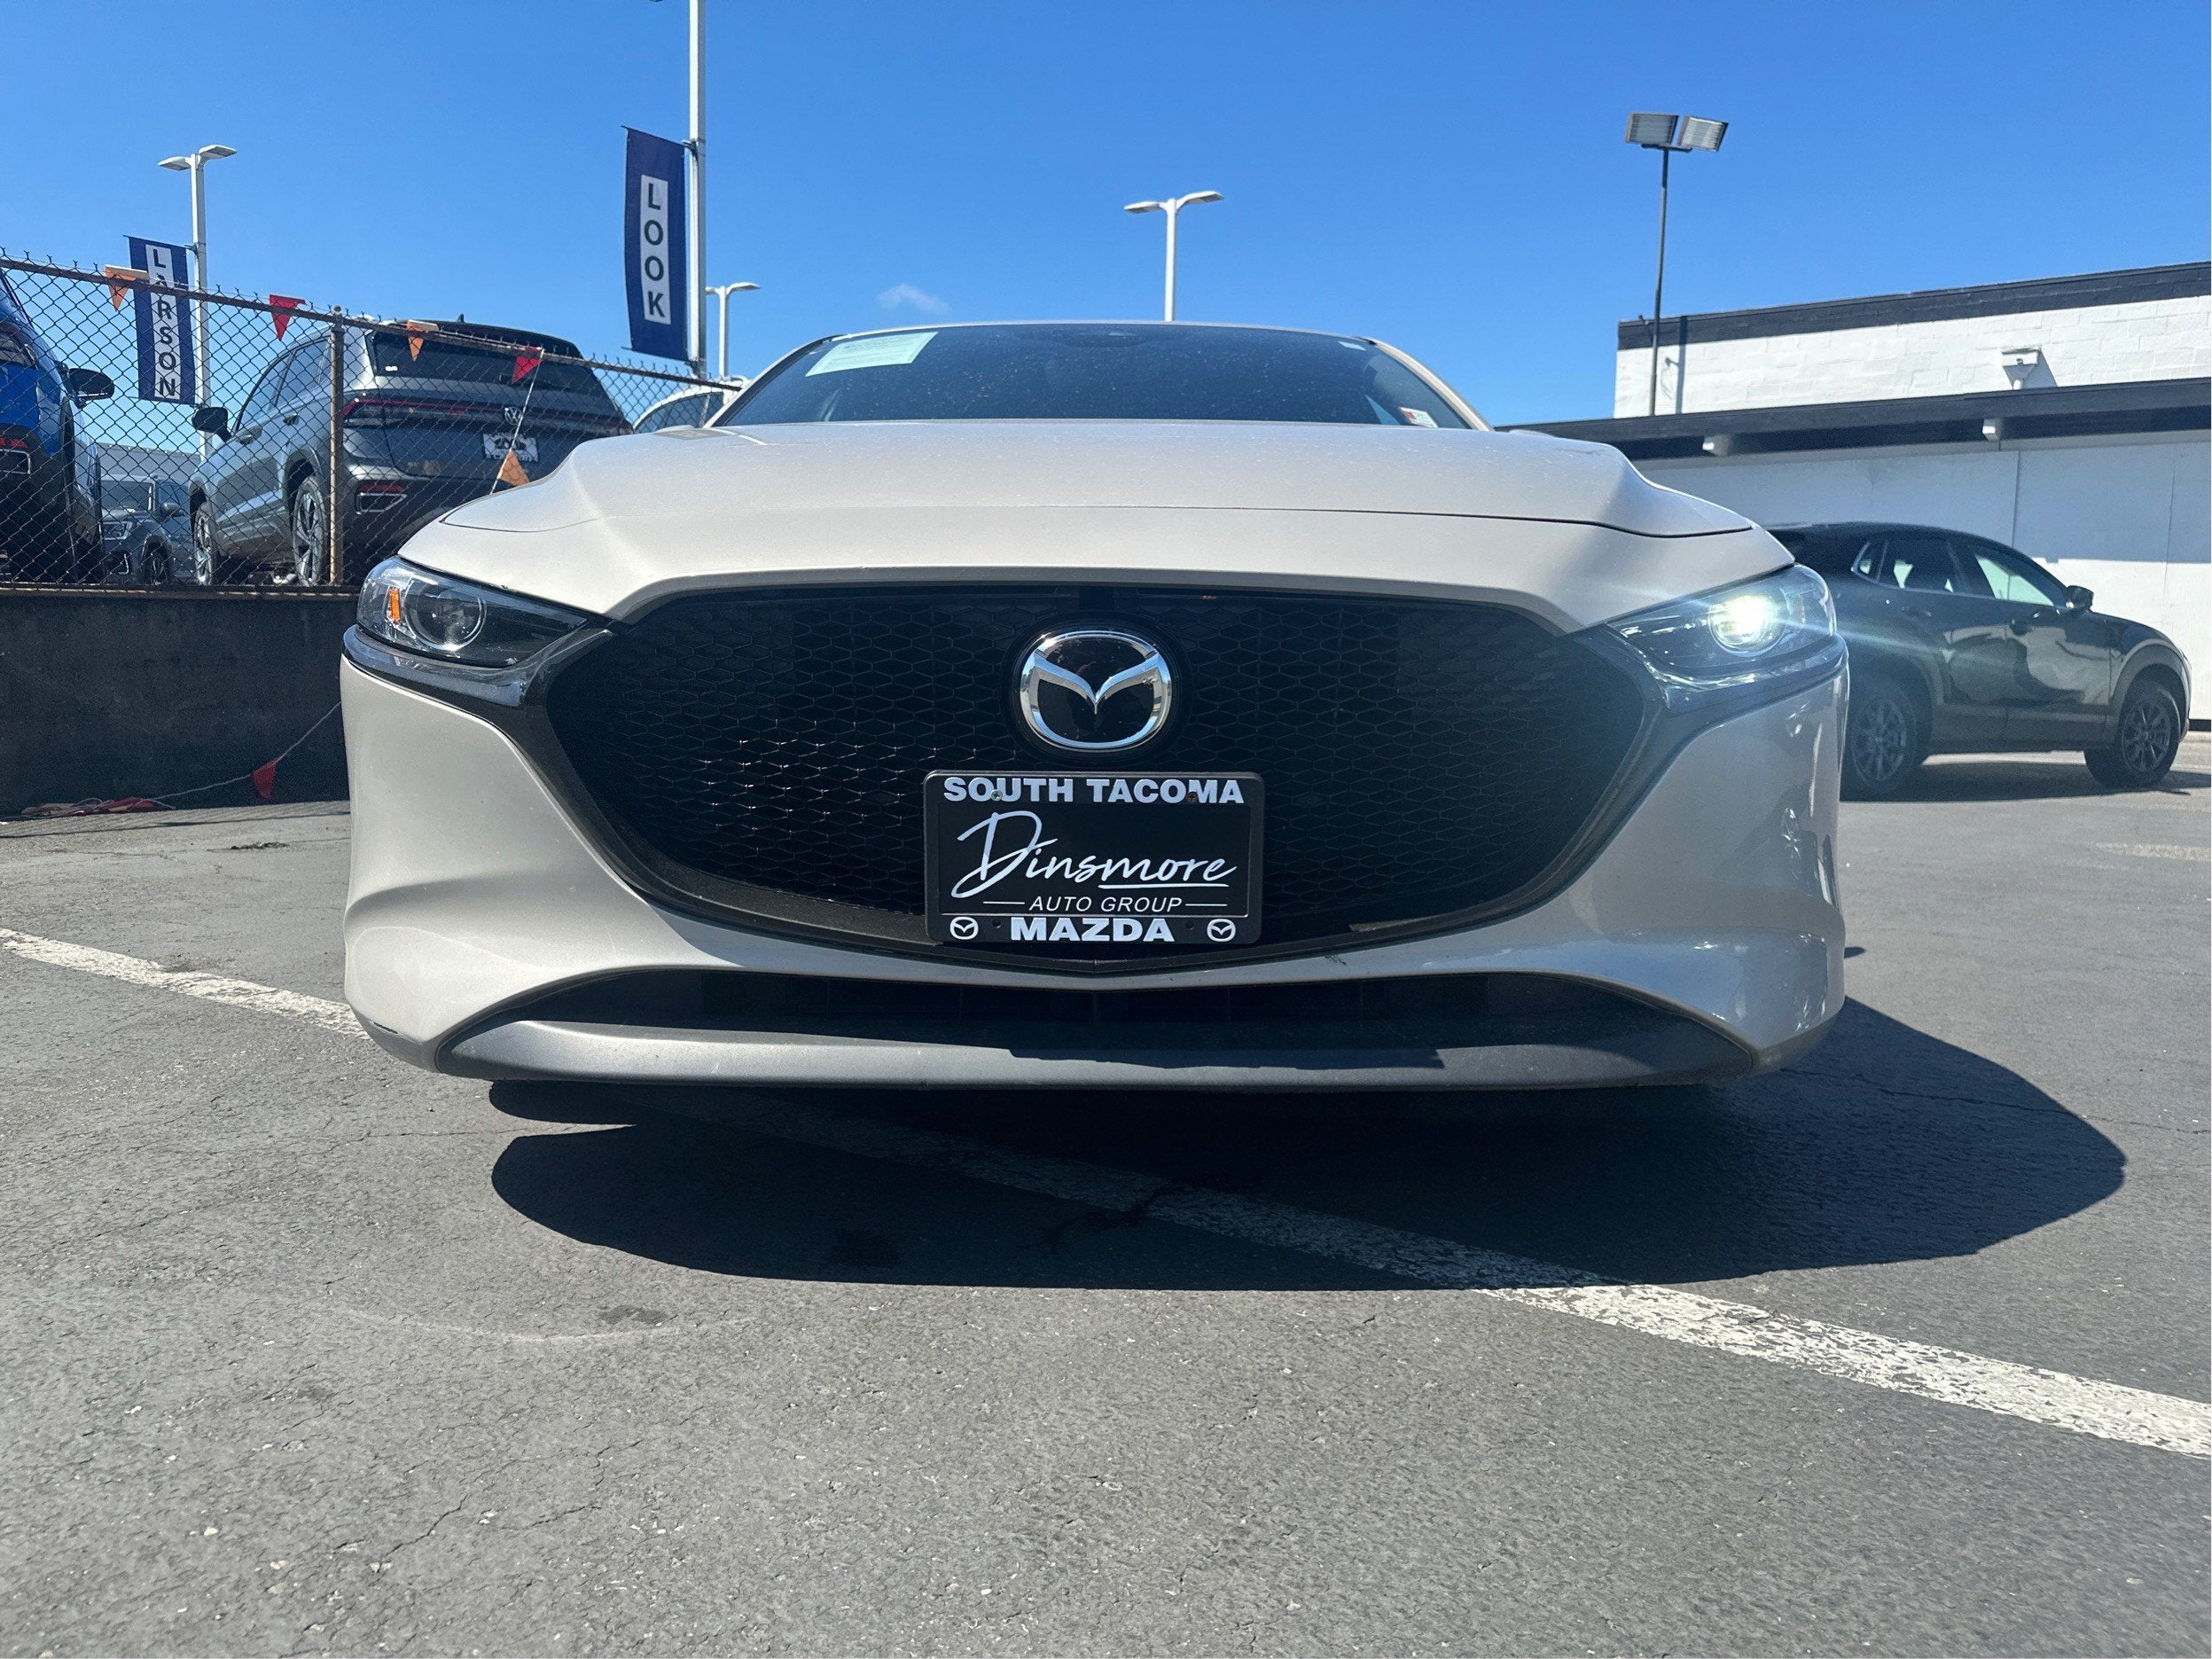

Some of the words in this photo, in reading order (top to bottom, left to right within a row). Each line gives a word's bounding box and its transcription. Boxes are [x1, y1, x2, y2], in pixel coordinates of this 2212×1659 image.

[644, 183, 665, 317] LOOK
[152, 248, 176, 397] LARSON
[943, 777, 1074, 803] SOUTH
[1086, 778, 1245, 804] TACOMA
[950, 810, 1238, 899] Dinsmore
[1011, 917, 1175, 943] MAZDA
[1028, 896, 1092, 912] AUTO
[1100, 896, 1183, 913] GROUP
